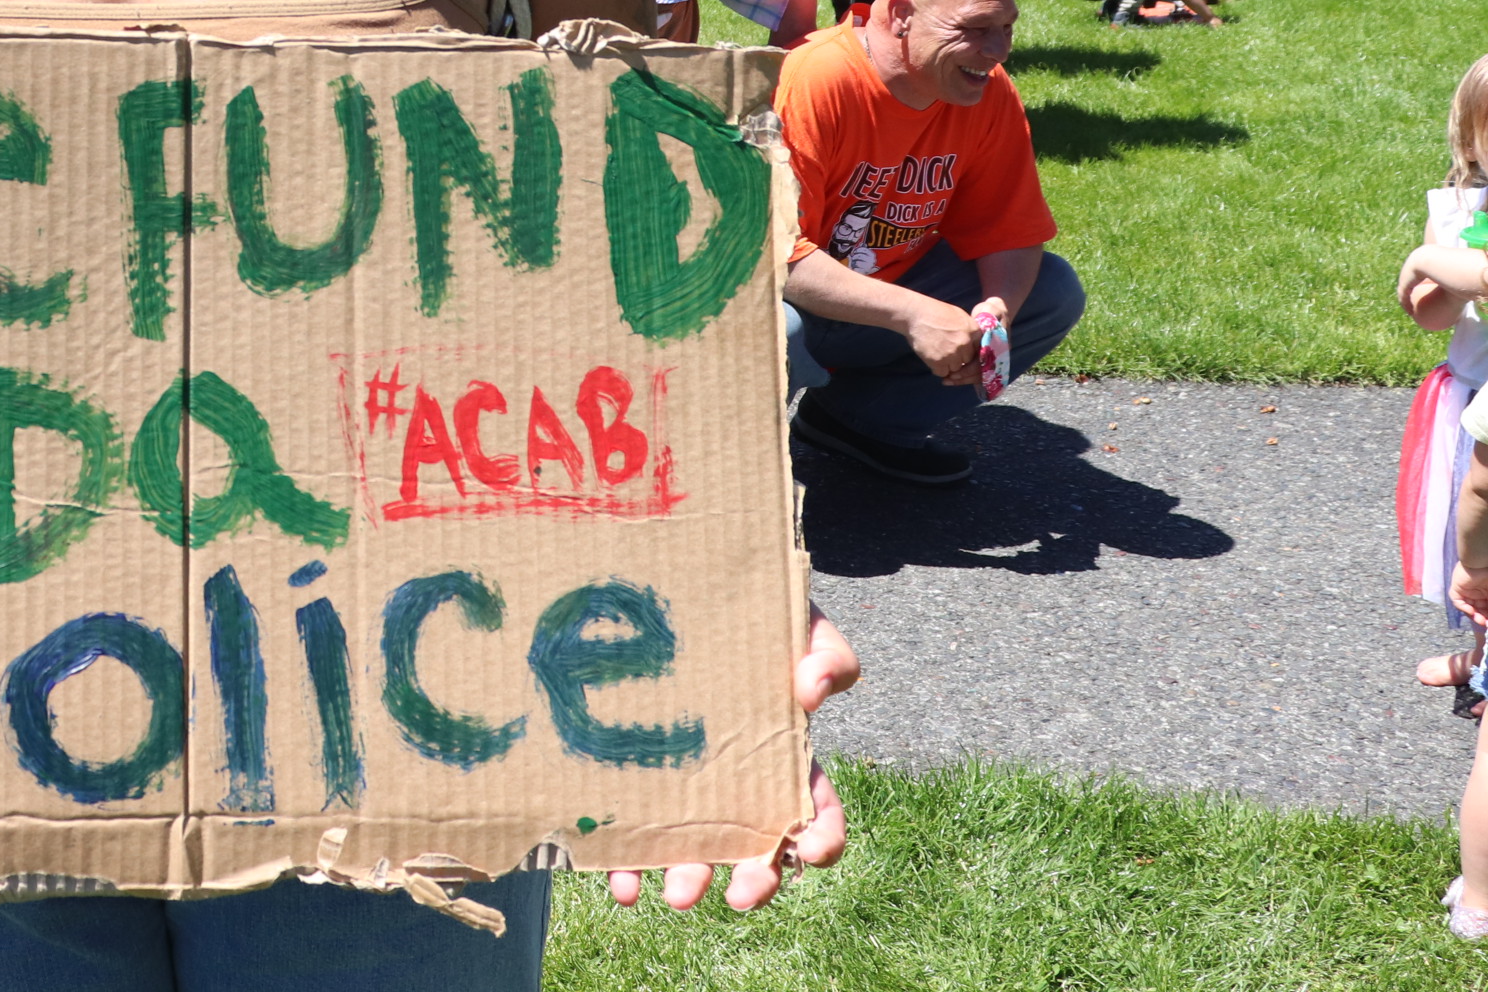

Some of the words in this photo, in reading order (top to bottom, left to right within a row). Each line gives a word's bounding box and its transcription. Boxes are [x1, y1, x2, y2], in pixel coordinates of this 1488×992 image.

[896, 153, 958, 195] DICK
[885, 201, 921, 223] DICK
[920, 200, 936, 220] IS
